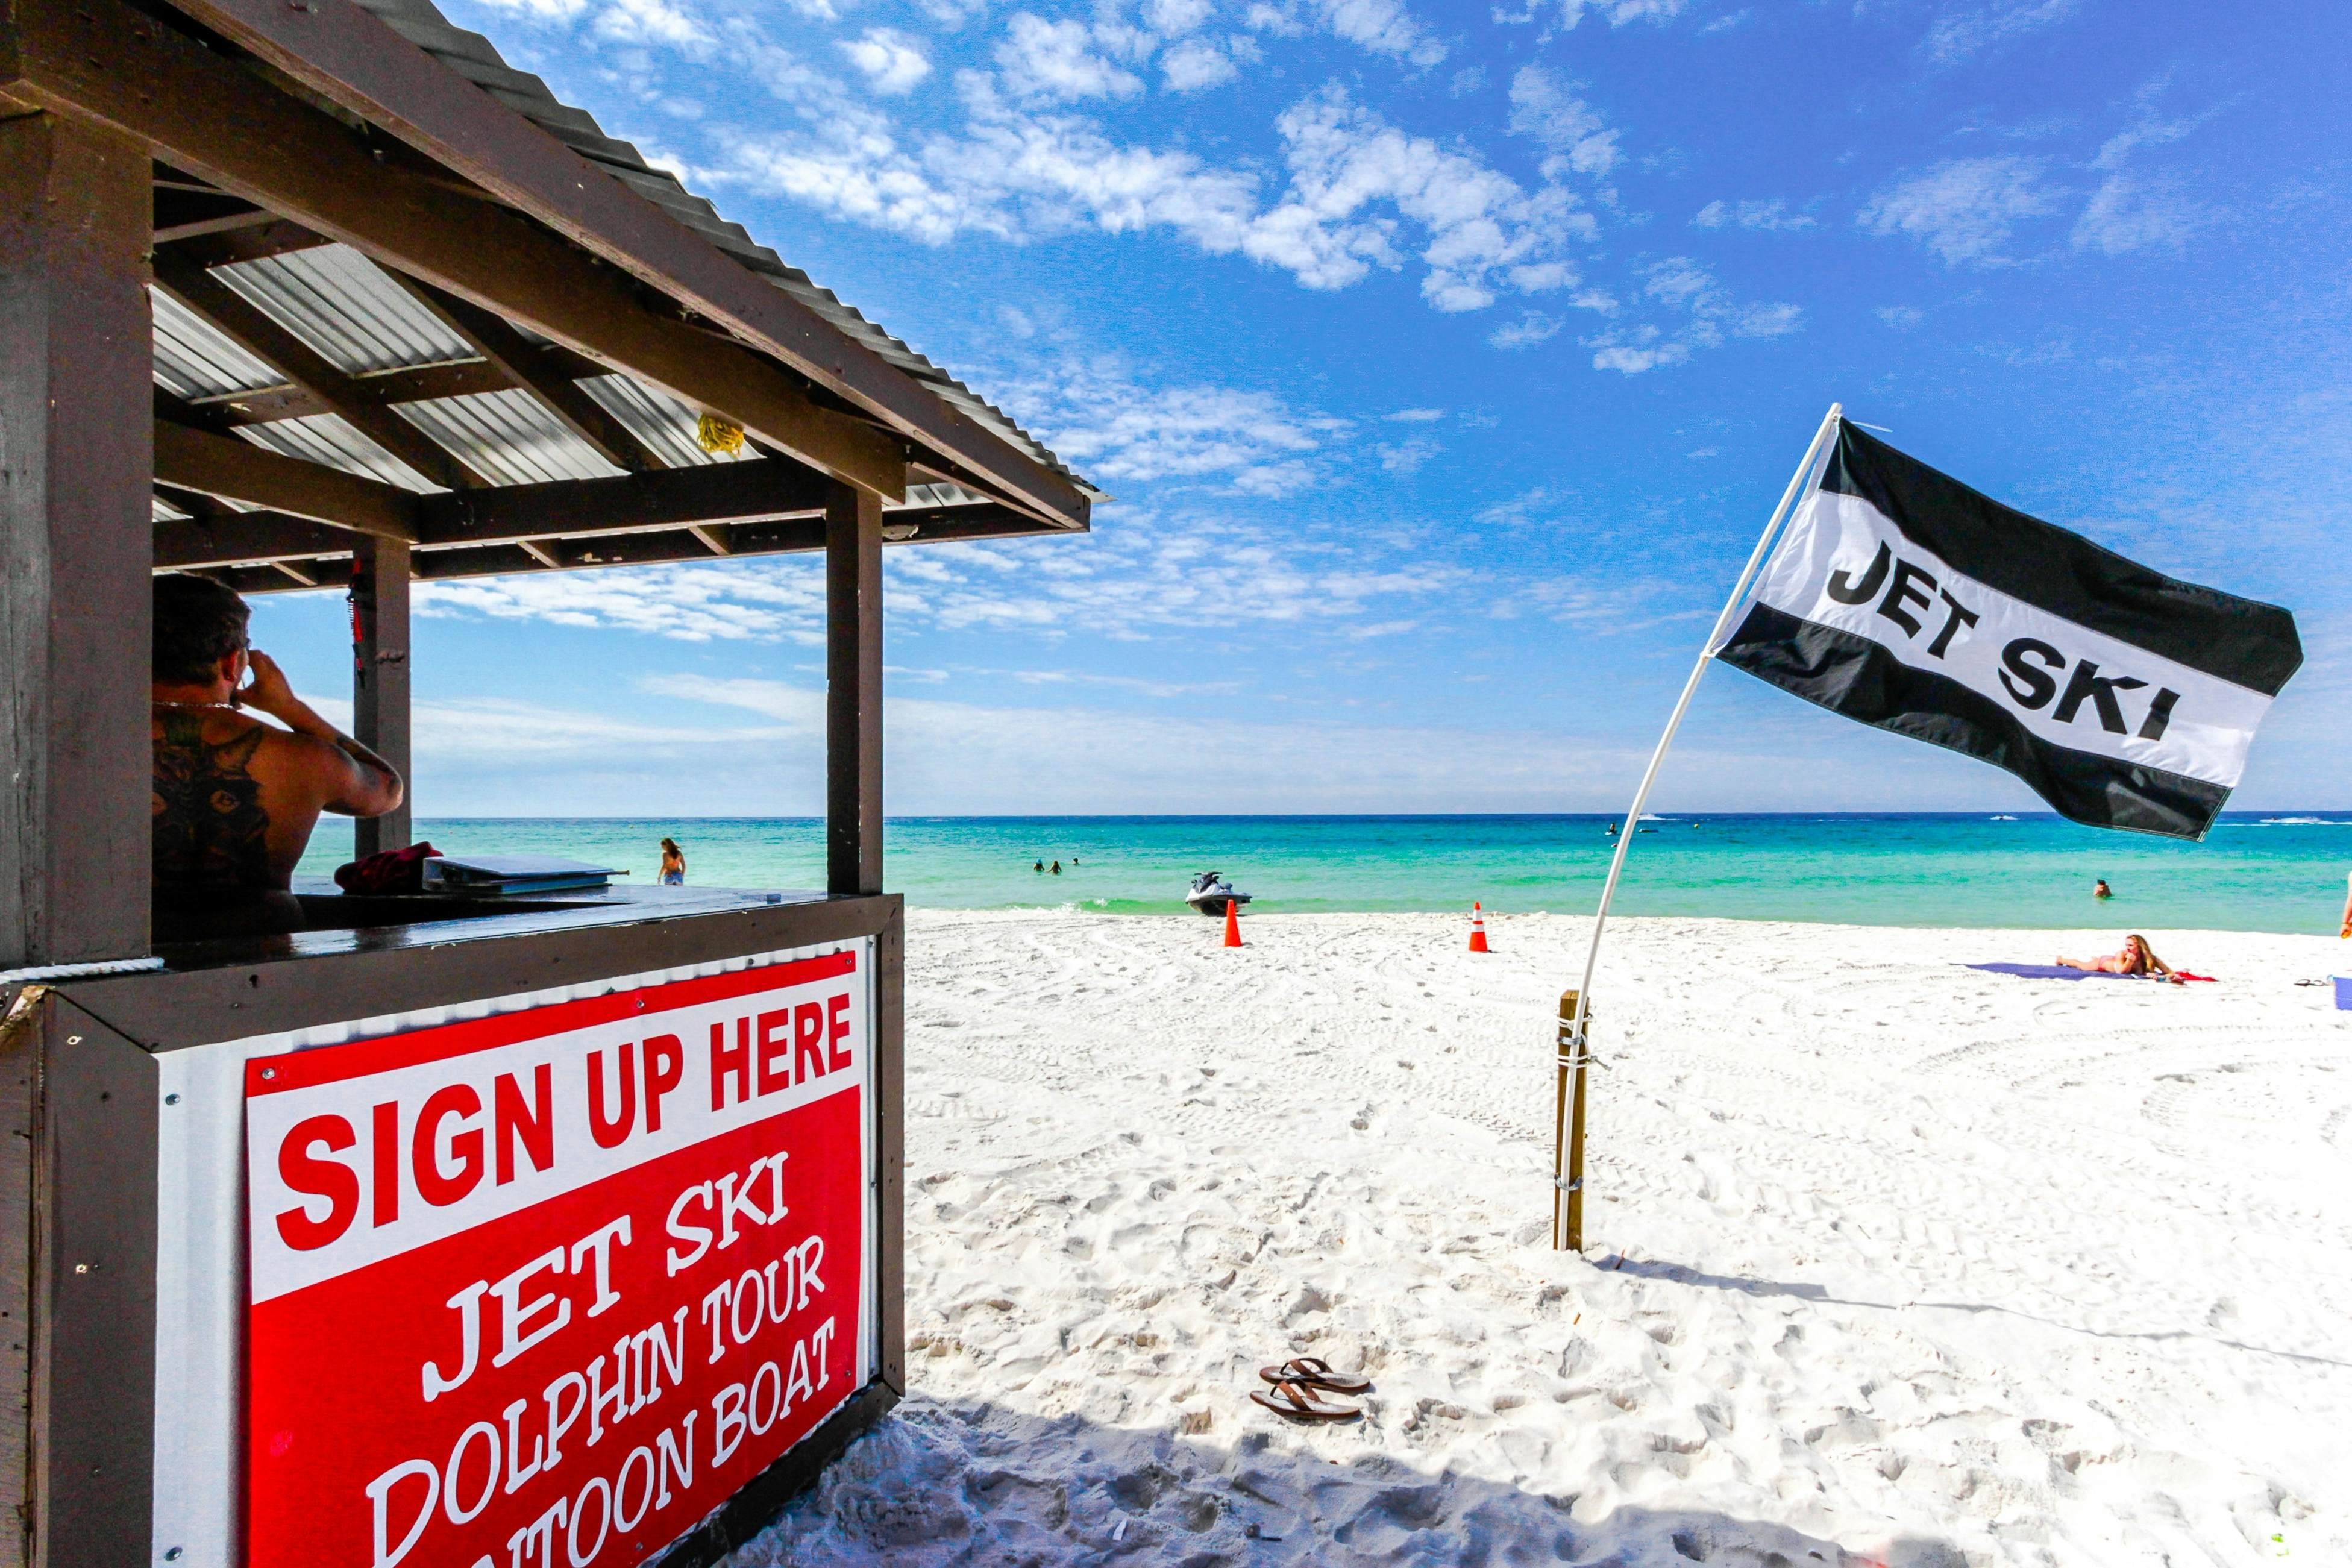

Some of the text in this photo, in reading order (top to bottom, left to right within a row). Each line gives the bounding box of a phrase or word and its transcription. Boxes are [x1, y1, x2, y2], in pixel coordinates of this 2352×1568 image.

[1828, 539, 2181, 741] JET SKI
[276, 993, 852, 1251] SIGN UP HERE
[366, 1235, 825, 1568] DOLPHIN TOUR
[422, 1151, 789, 1402] JET SKI
[712, 1316, 835, 1468] BOAT
